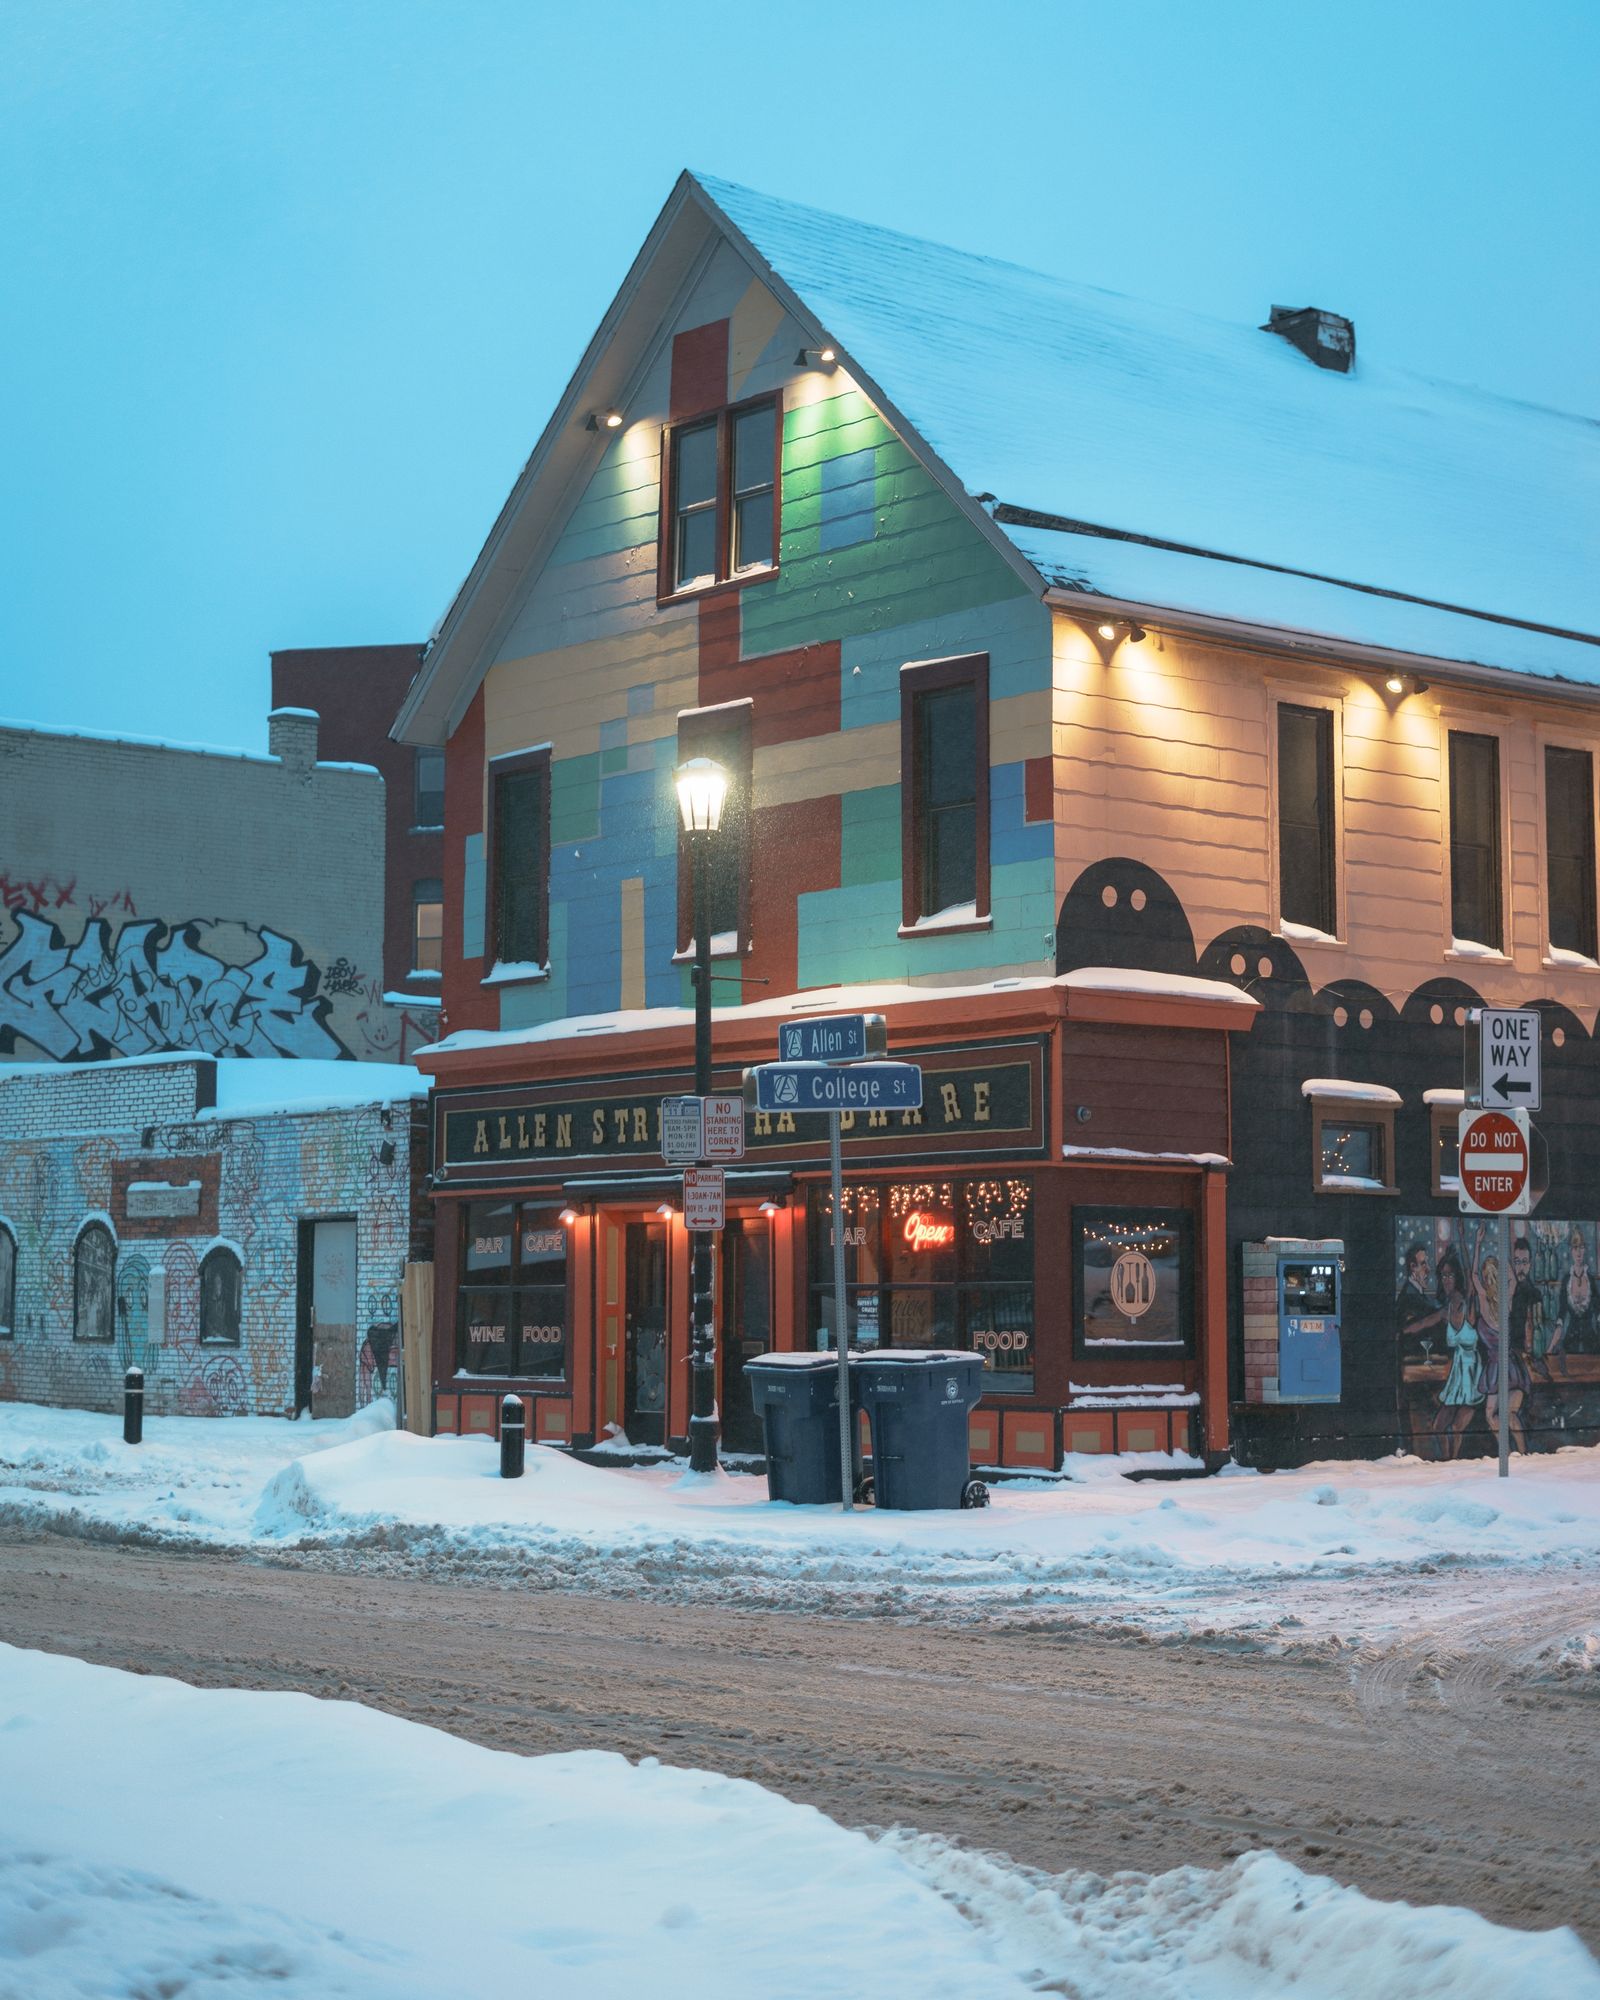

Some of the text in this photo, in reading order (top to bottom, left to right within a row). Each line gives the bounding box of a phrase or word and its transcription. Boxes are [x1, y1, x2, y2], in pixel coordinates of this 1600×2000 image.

[1492, 1018, 1530, 1040] ONE
[811, 1029, 857, 1054] Allen St
[1491, 1045, 1531, 1067] WAY
[812, 1076, 906, 1105] College St
[716, 1103, 731, 1114] NO
[473, 1113, 572, 1153] ALLEN
[708, 1127, 740, 1135] HERE TO
[708, 1137, 740, 1145] CORNER
[1470, 1132, 1518, 1148] DO NOT
[685, 1172, 722, 1184] NO PARKING
[1475, 1176, 1513, 1192] ENTER
[686, 1204, 697, 1212] NOV
[708, 1204, 719, 1212] APR
[904, 1212, 948, 1251] Open
[972, 1215, 1025, 1240] CAFÉ
[475, 1230, 563, 1254] BAR CAFÉ
[1303, 1242, 1323, 1250] ATM
[1311, 1266, 1332, 1275] ATM
[469, 1325, 562, 1343] WINE FOOD
[1303, 1322, 1323, 1330] ATM
[973, 1331, 1027, 1350] FOOD
